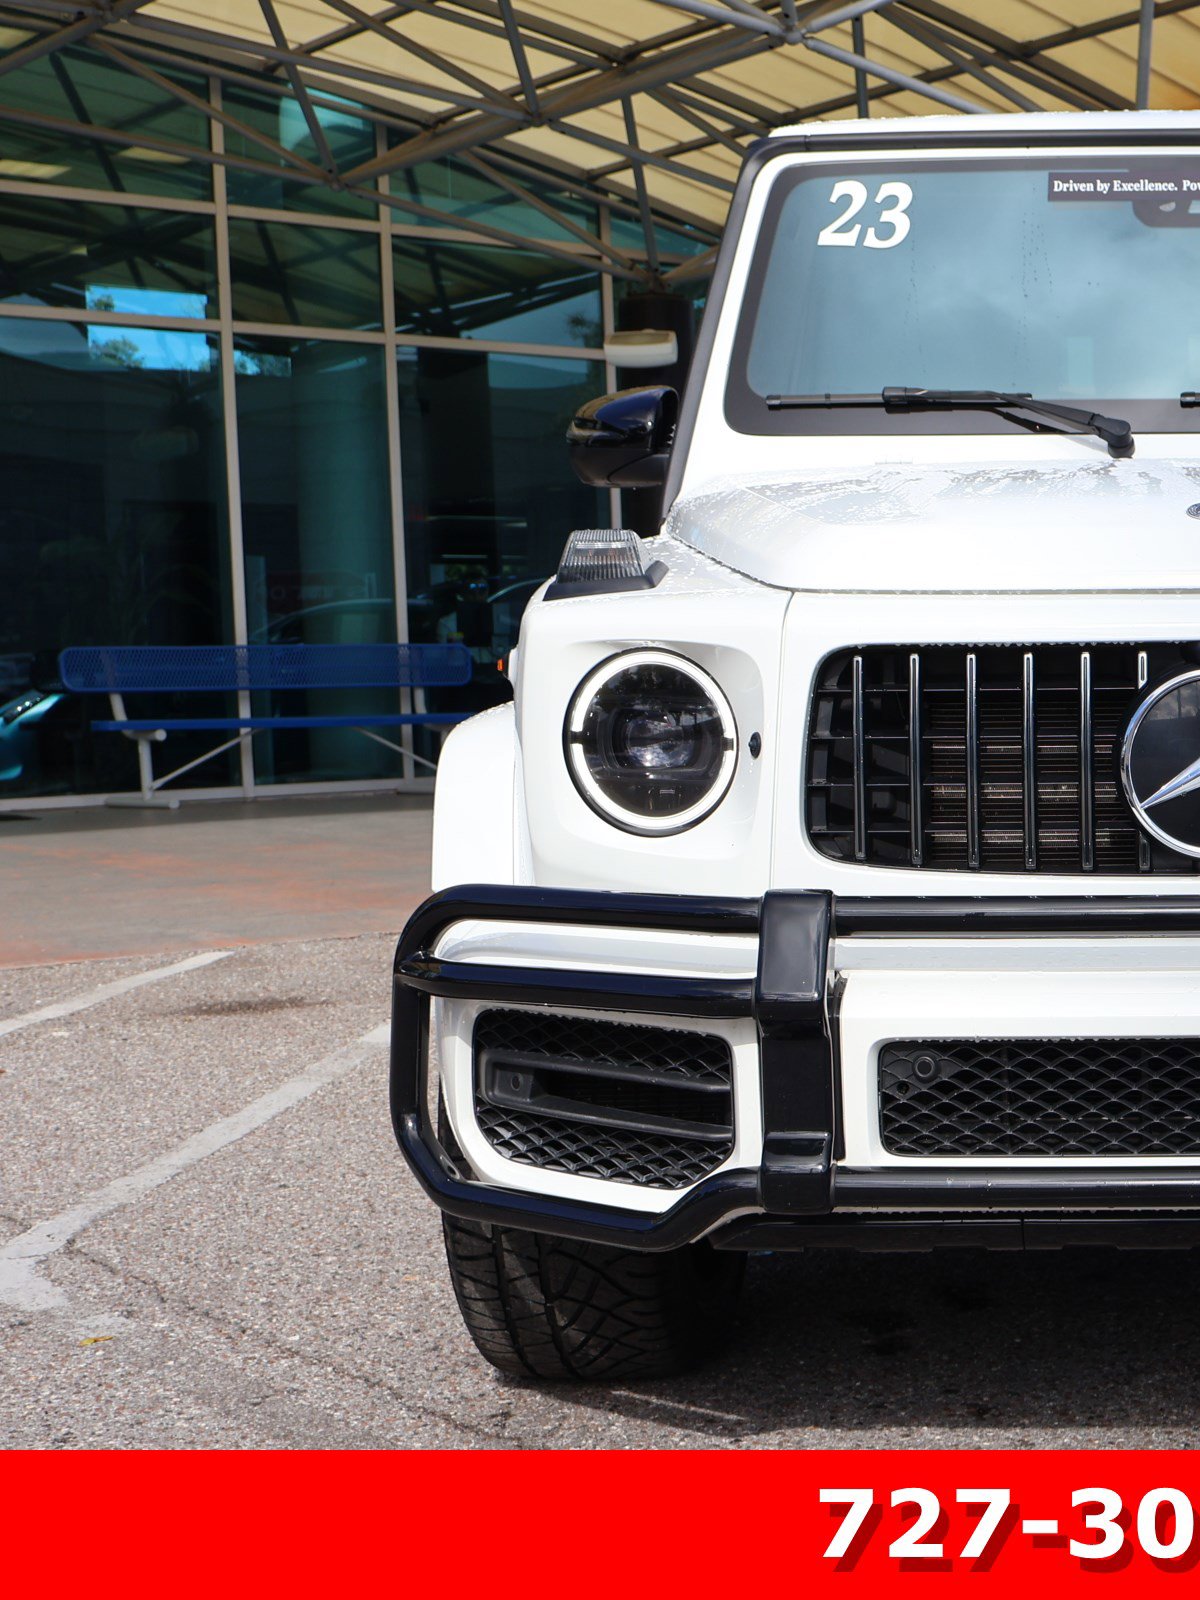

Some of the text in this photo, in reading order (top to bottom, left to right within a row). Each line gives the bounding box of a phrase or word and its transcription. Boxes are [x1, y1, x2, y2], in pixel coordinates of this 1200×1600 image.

[1053, 180, 1094, 192] Driven
[1097, 179, 1110, 194] by
[1113, 179, 1178, 192] Excellence.
[817, 180, 913, 249] 23
